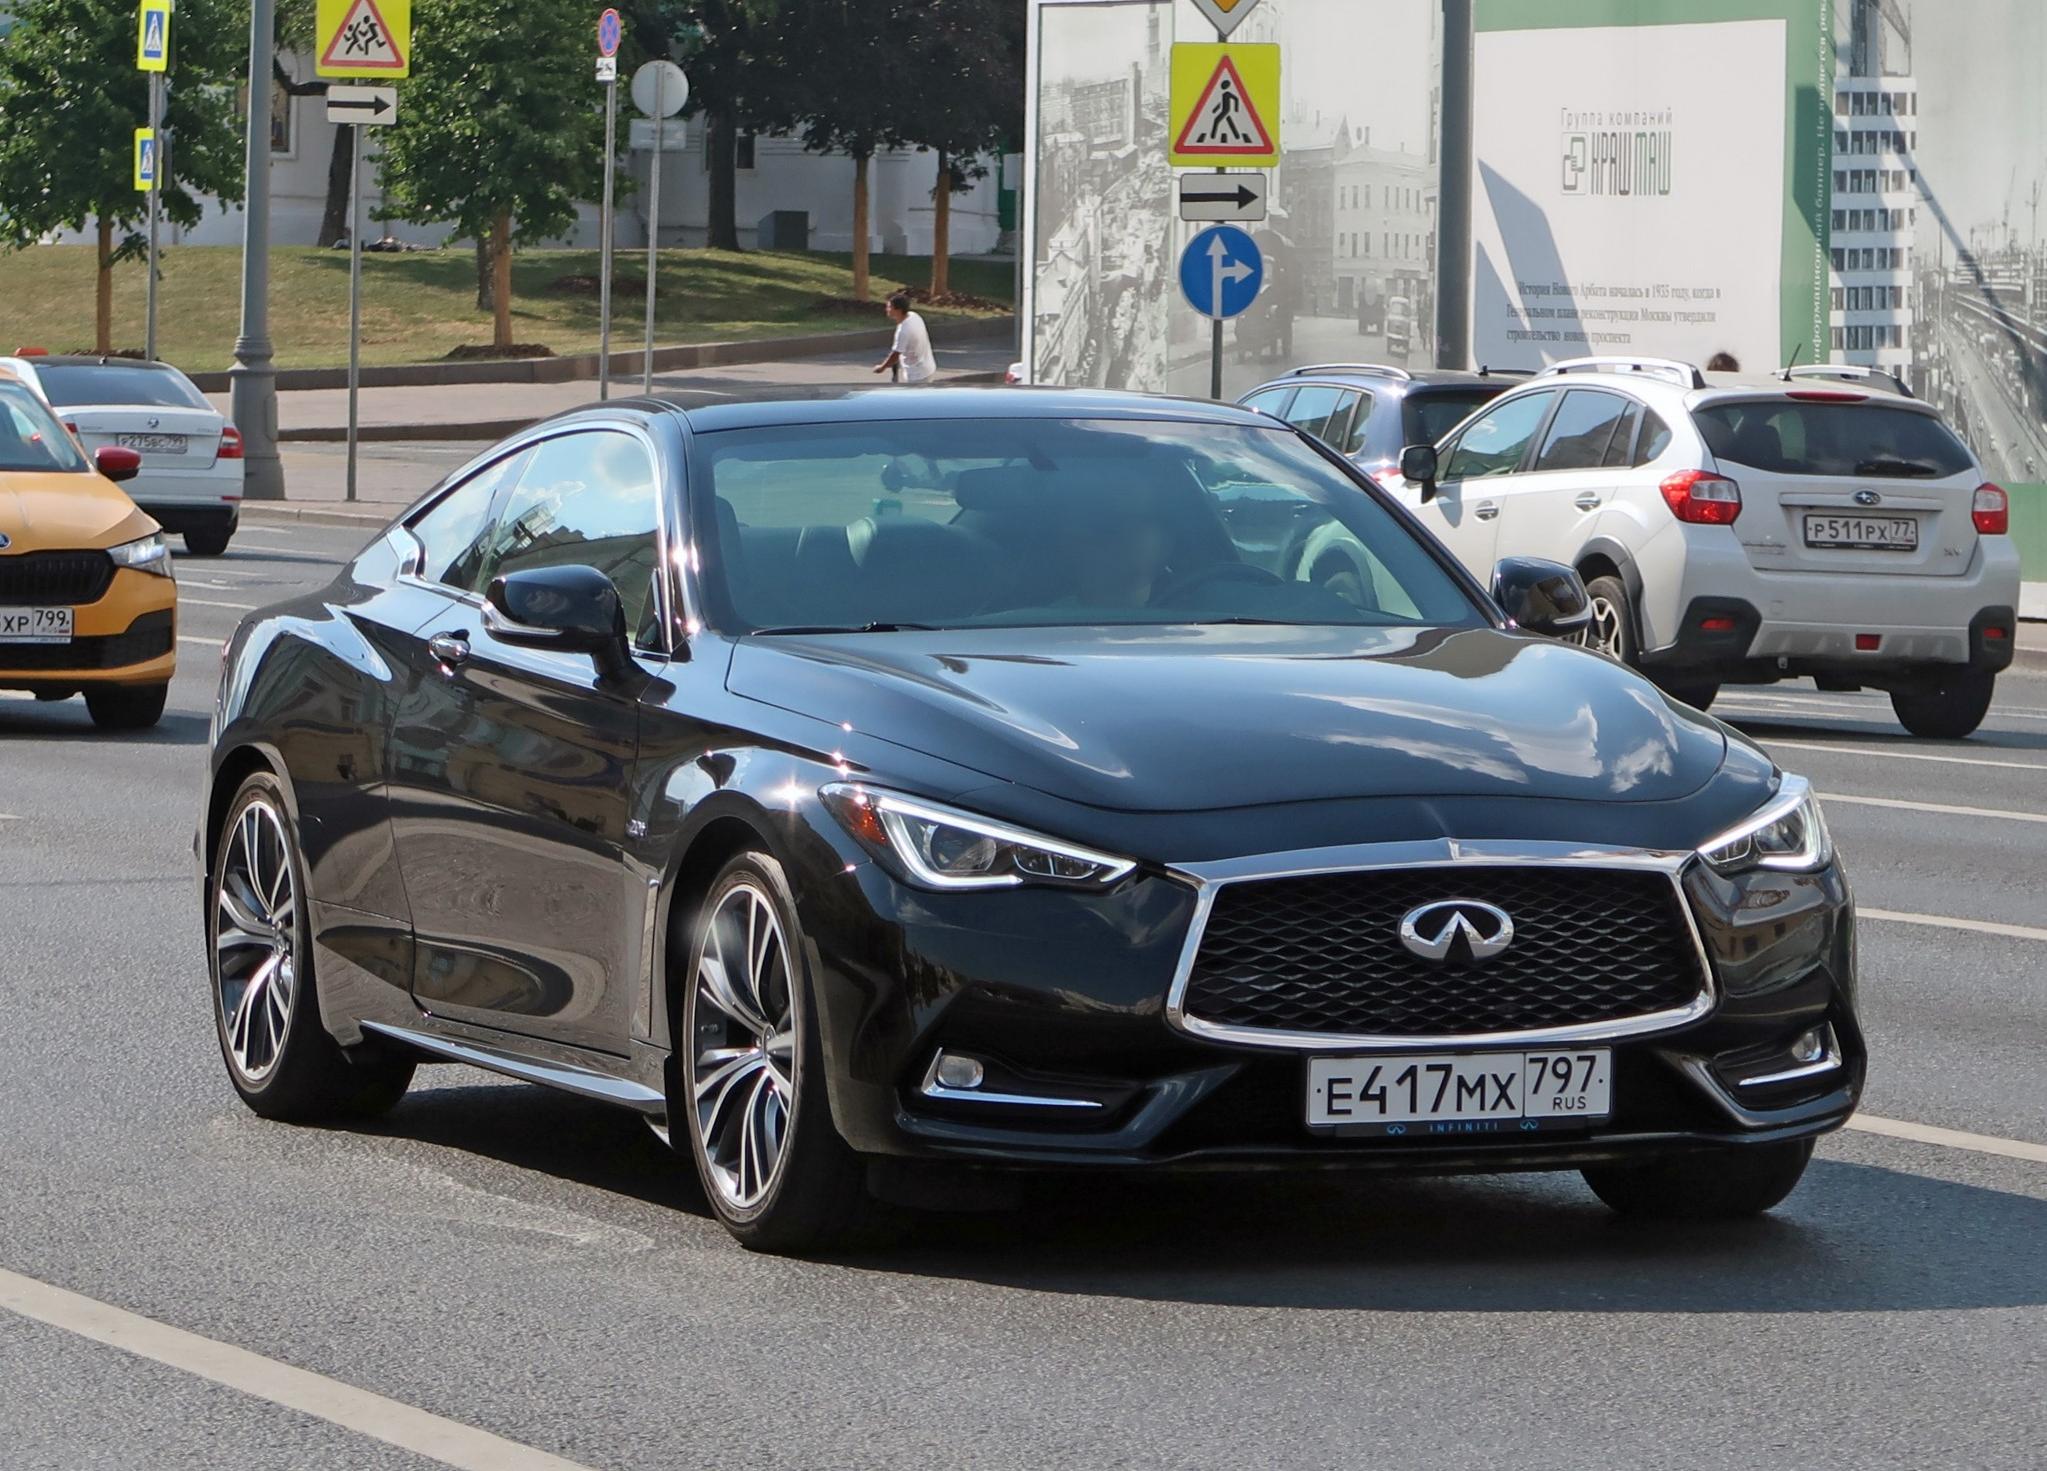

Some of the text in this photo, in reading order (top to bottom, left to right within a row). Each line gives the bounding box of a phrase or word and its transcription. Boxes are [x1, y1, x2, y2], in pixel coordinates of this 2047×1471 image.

[1561, 106, 1672, 130] Группа компаний
[1817, 116, 1825, 138] Не
[1518, 281, 1550, 300] История
[1581, 282, 1607, 300] Арбата
[1609, 286, 1643, 298] началась
[1641, 307, 1672, 322] Москвы
[1814, 520, 1910, 541] Р511РХ 77
[35, 609, 66, 627] 799
[1327, 1055, 1597, 1116] Е417МХ 797
[1552, 1096, 1587, 1111] RUS
[1429, 1121, 1500, 1133] INFINITI
